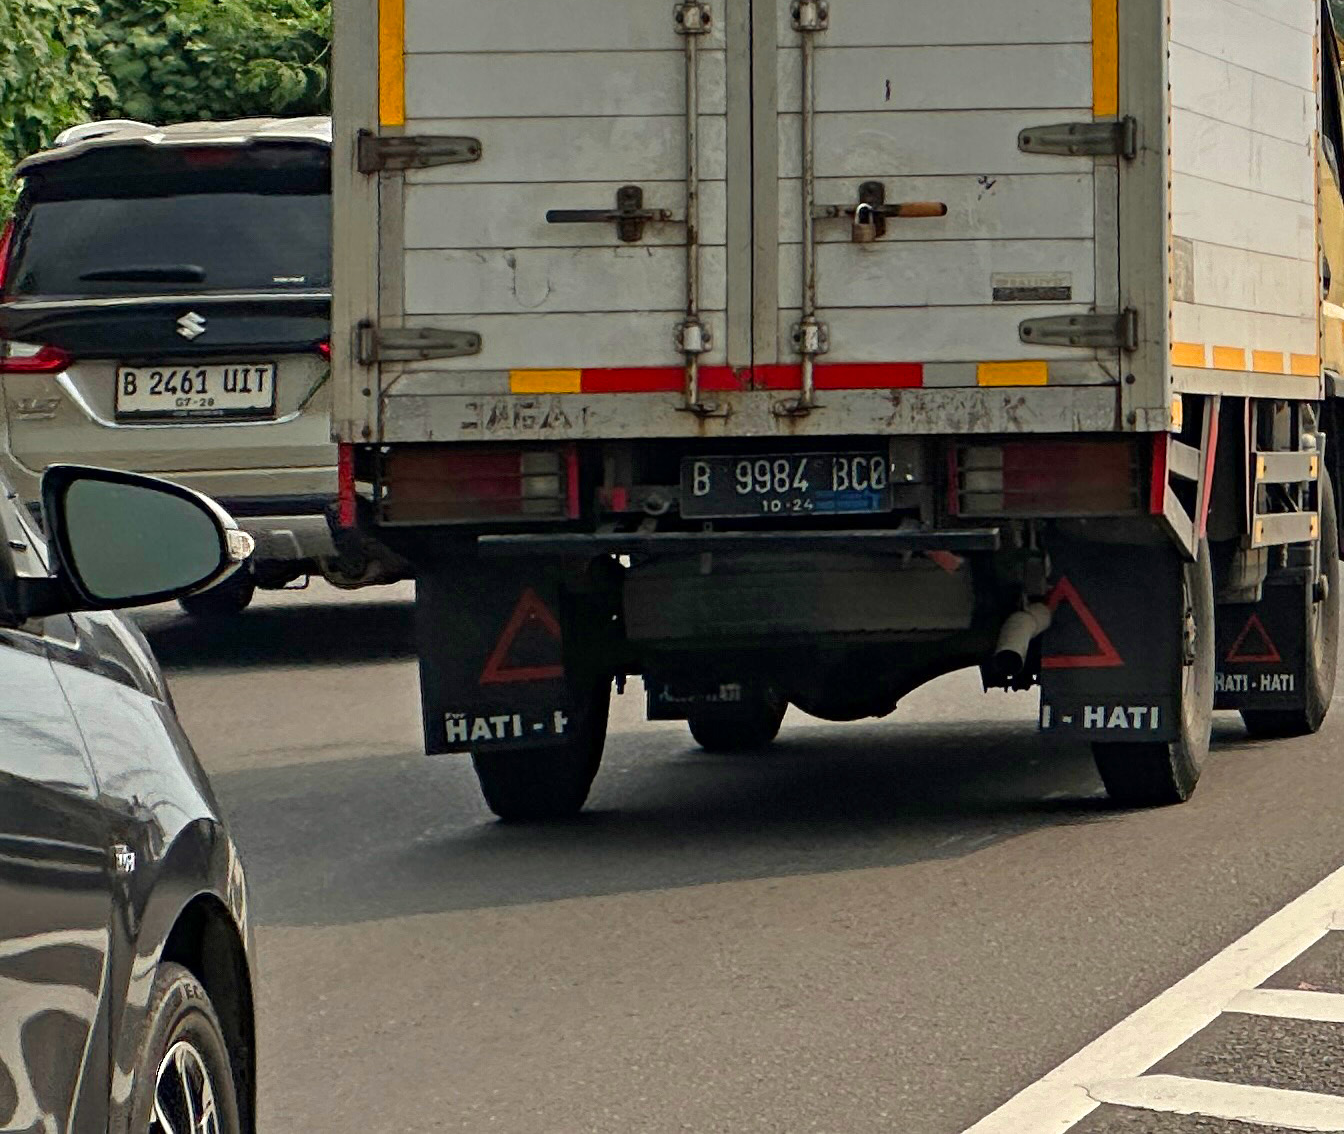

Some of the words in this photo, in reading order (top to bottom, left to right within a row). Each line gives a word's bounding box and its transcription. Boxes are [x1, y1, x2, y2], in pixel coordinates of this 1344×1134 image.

[124, 371, 136, 395] B
[150, 369, 208, 395] 2461
[223, 368, 268, 393] UIT
[693, 462, 710, 496] B
[735, 458, 810, 494] 9984
[1260, 673, 1295, 691] HATI
[445, 714, 522, 743] HATI
[1083, 705, 1160, 729] HATI
